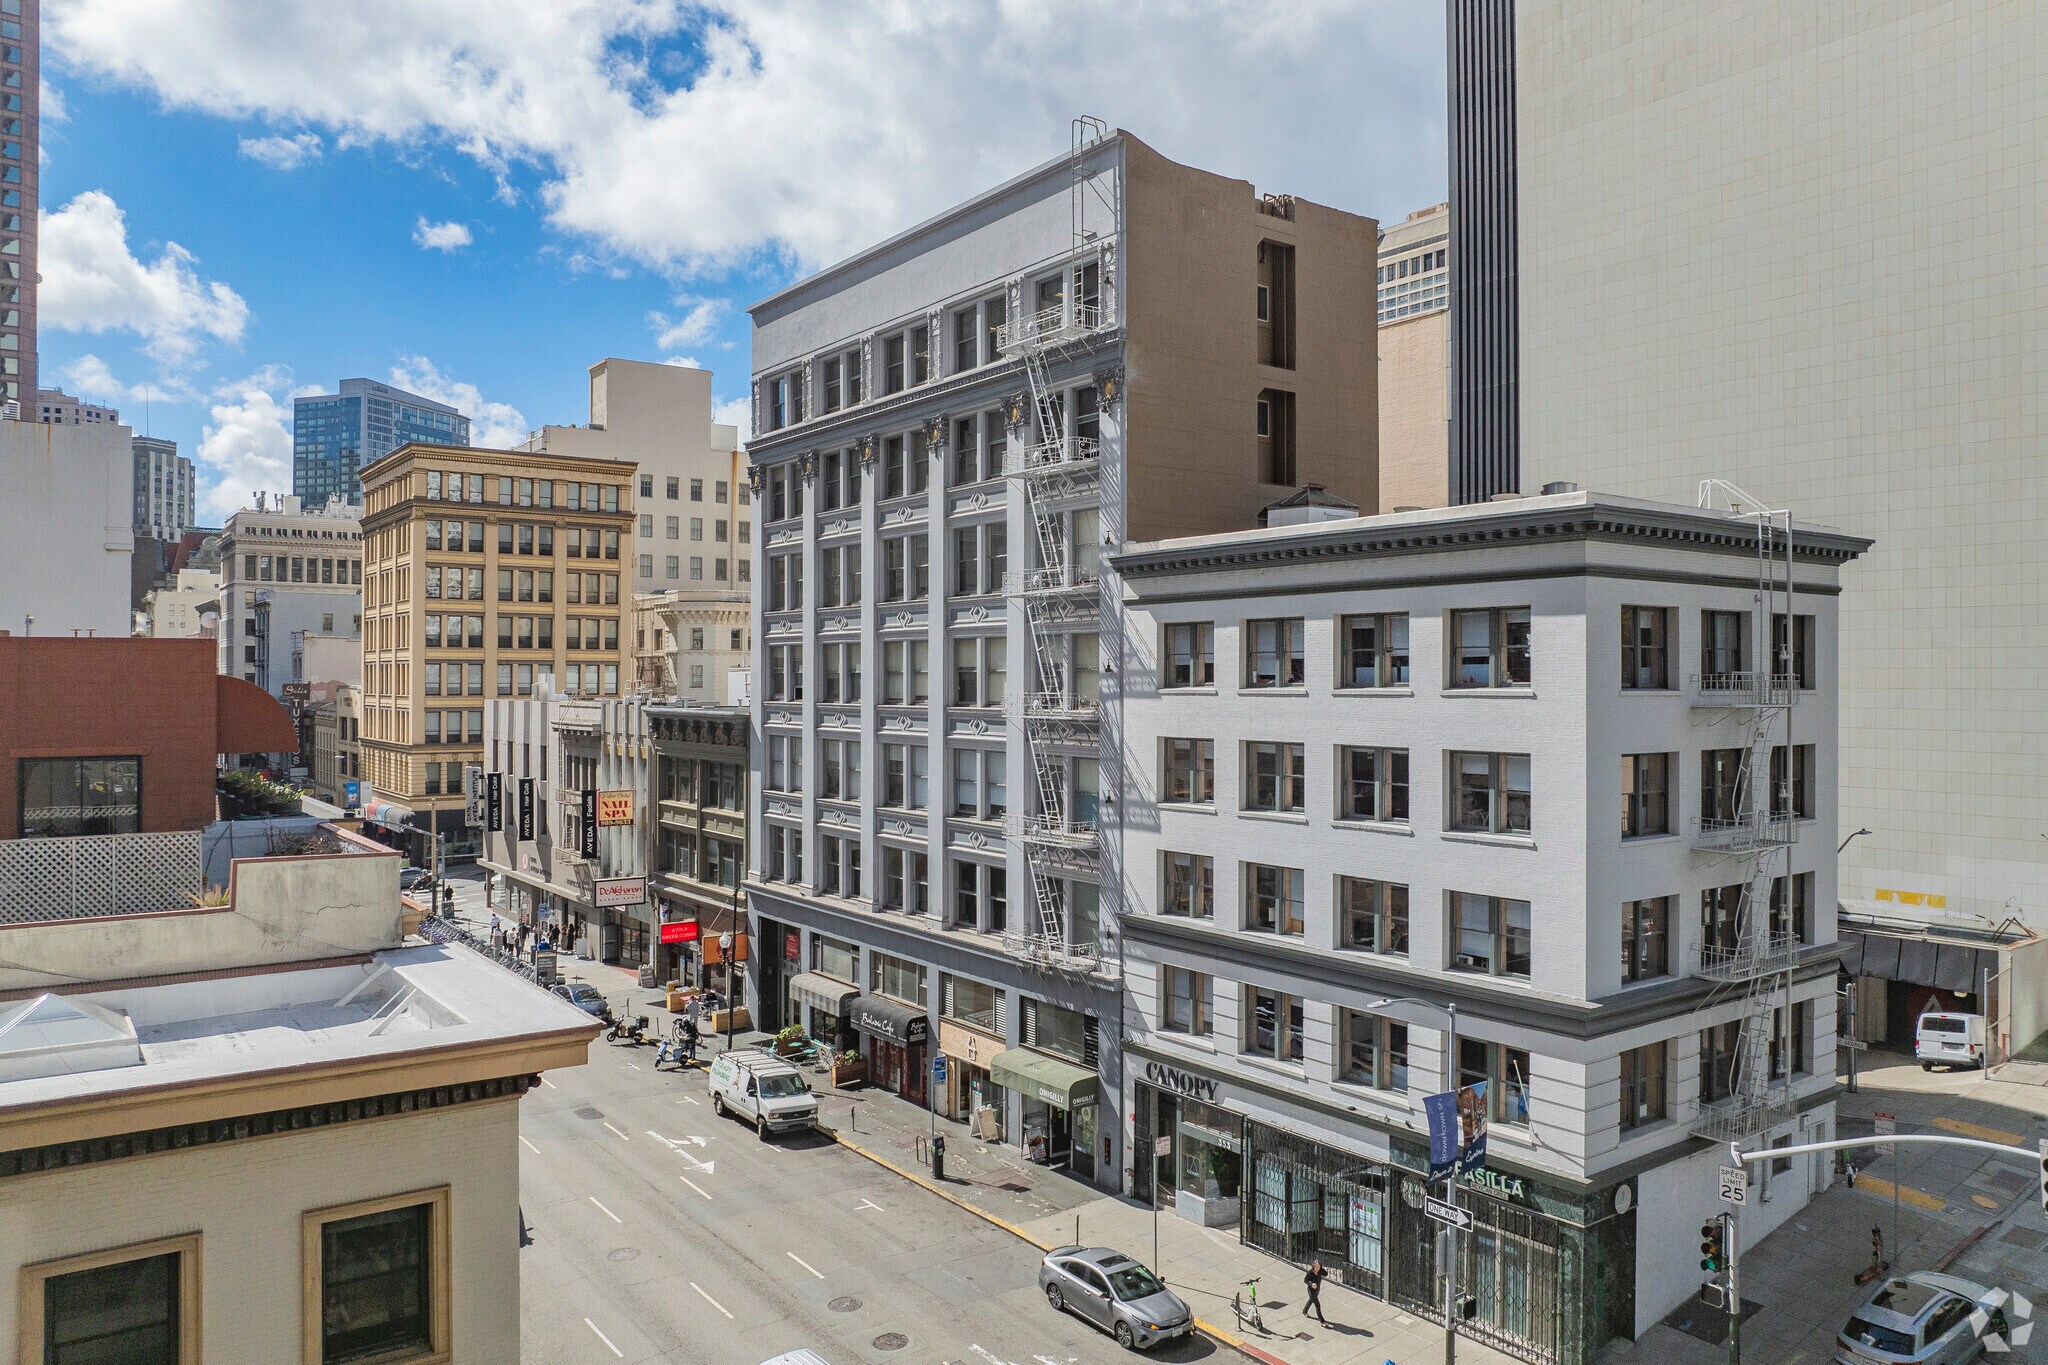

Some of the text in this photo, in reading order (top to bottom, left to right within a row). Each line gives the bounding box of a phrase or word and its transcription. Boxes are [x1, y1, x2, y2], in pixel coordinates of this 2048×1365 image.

[284, 685, 308, 695] Selix
[601, 800, 631, 809] NAIL
[604, 810, 627, 818] SPA
[1146, 1062, 1219, 1100] CANOPY
[1039, 1087, 1064, 1103] ONIGILLY
[1072, 1094, 1095, 1105] ONIGILLY
[1439, 1112, 1448, 1162] DOWNTOWN
[1217, 1139, 1231, 1149] 353
[1455, 1160, 1524, 1198] PASILLA
[1720, 1169, 1745, 1180] SPEED
[1723, 1177, 1741, 1187] LIMIT
[1721, 1185, 1744, 1201] 25
[1429, 1203, 1459, 1221] ONE WAY
